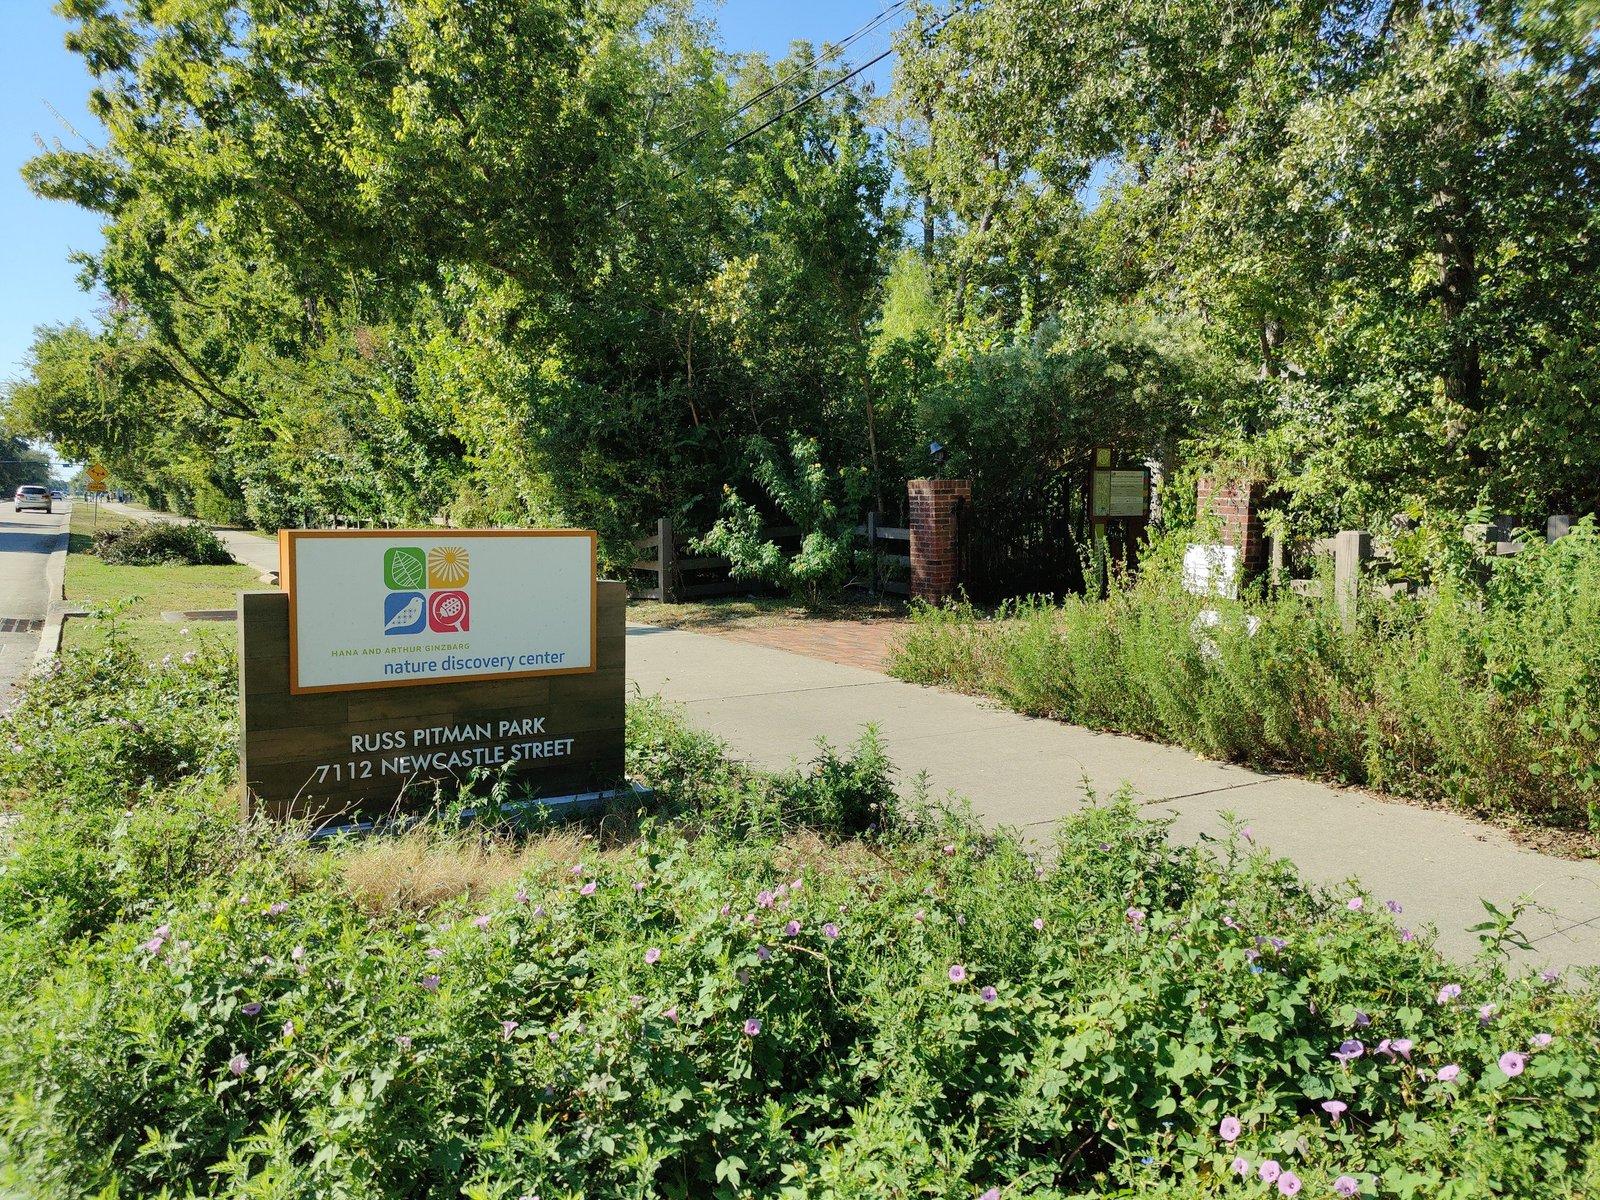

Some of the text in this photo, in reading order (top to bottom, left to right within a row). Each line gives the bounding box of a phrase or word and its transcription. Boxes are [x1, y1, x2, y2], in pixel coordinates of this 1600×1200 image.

[331, 643, 470, 657] HANA AND ARTHUR GINZBARG
[384, 651, 566, 675] nature discovery center
[351, 717, 546, 753] RUSS PITMAN PARK
[317, 738, 575, 784] 7112 NEWCASTLE STREET
